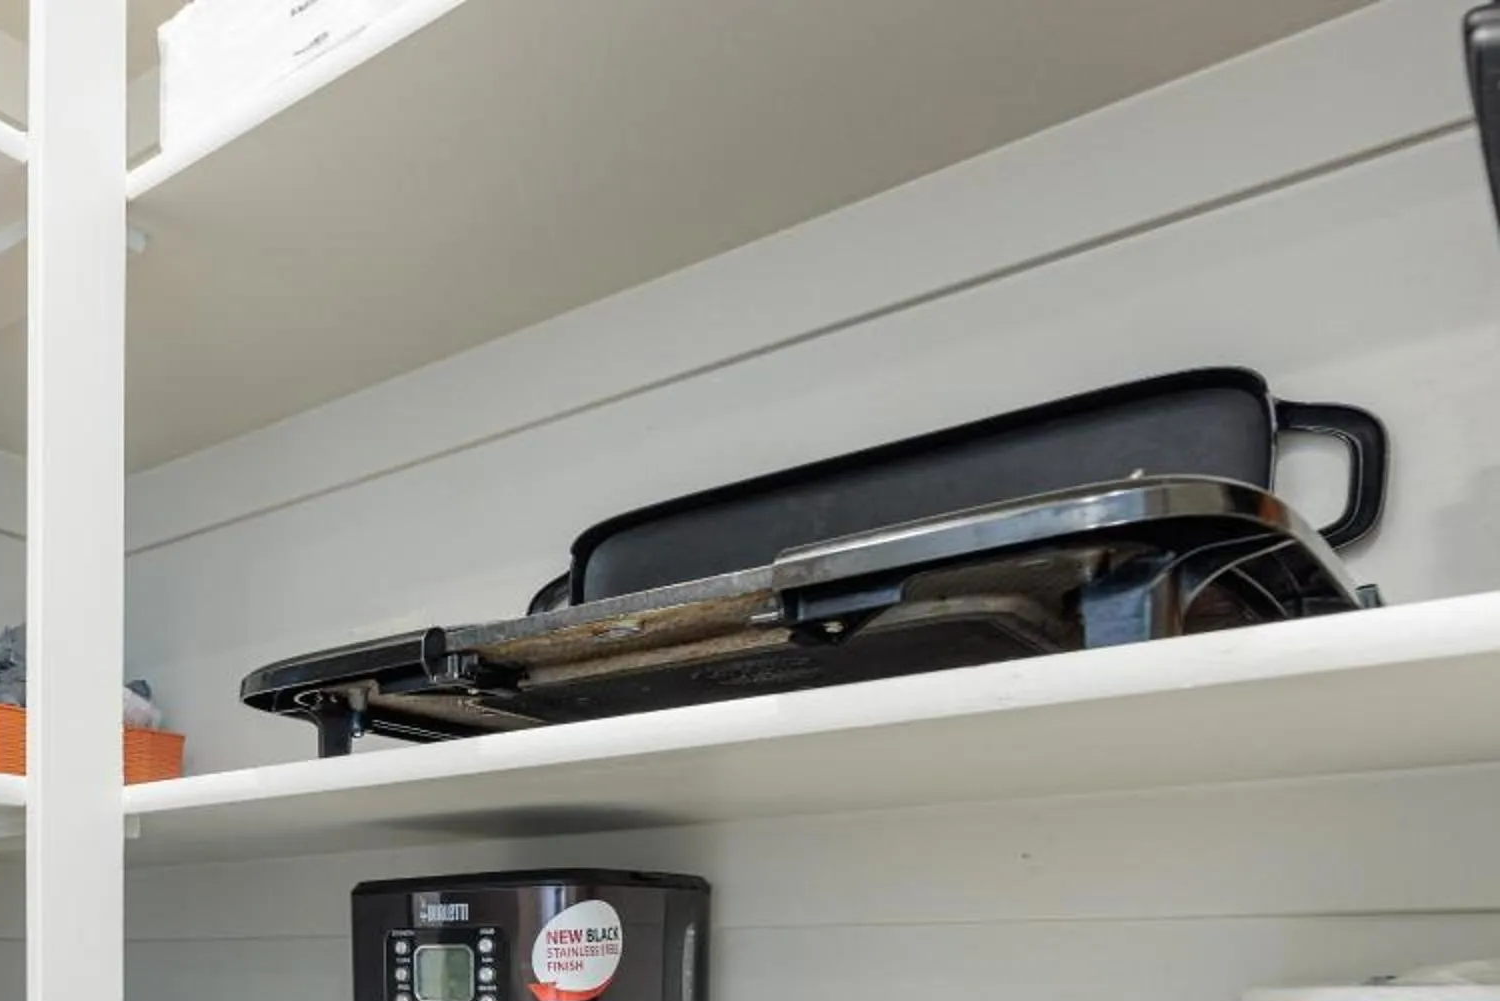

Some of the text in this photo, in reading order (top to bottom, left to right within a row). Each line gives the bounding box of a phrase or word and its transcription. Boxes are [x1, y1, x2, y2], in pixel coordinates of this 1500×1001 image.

[546, 926, 619, 945] NEW BLACK
[546, 962, 584, 973] FINISH
